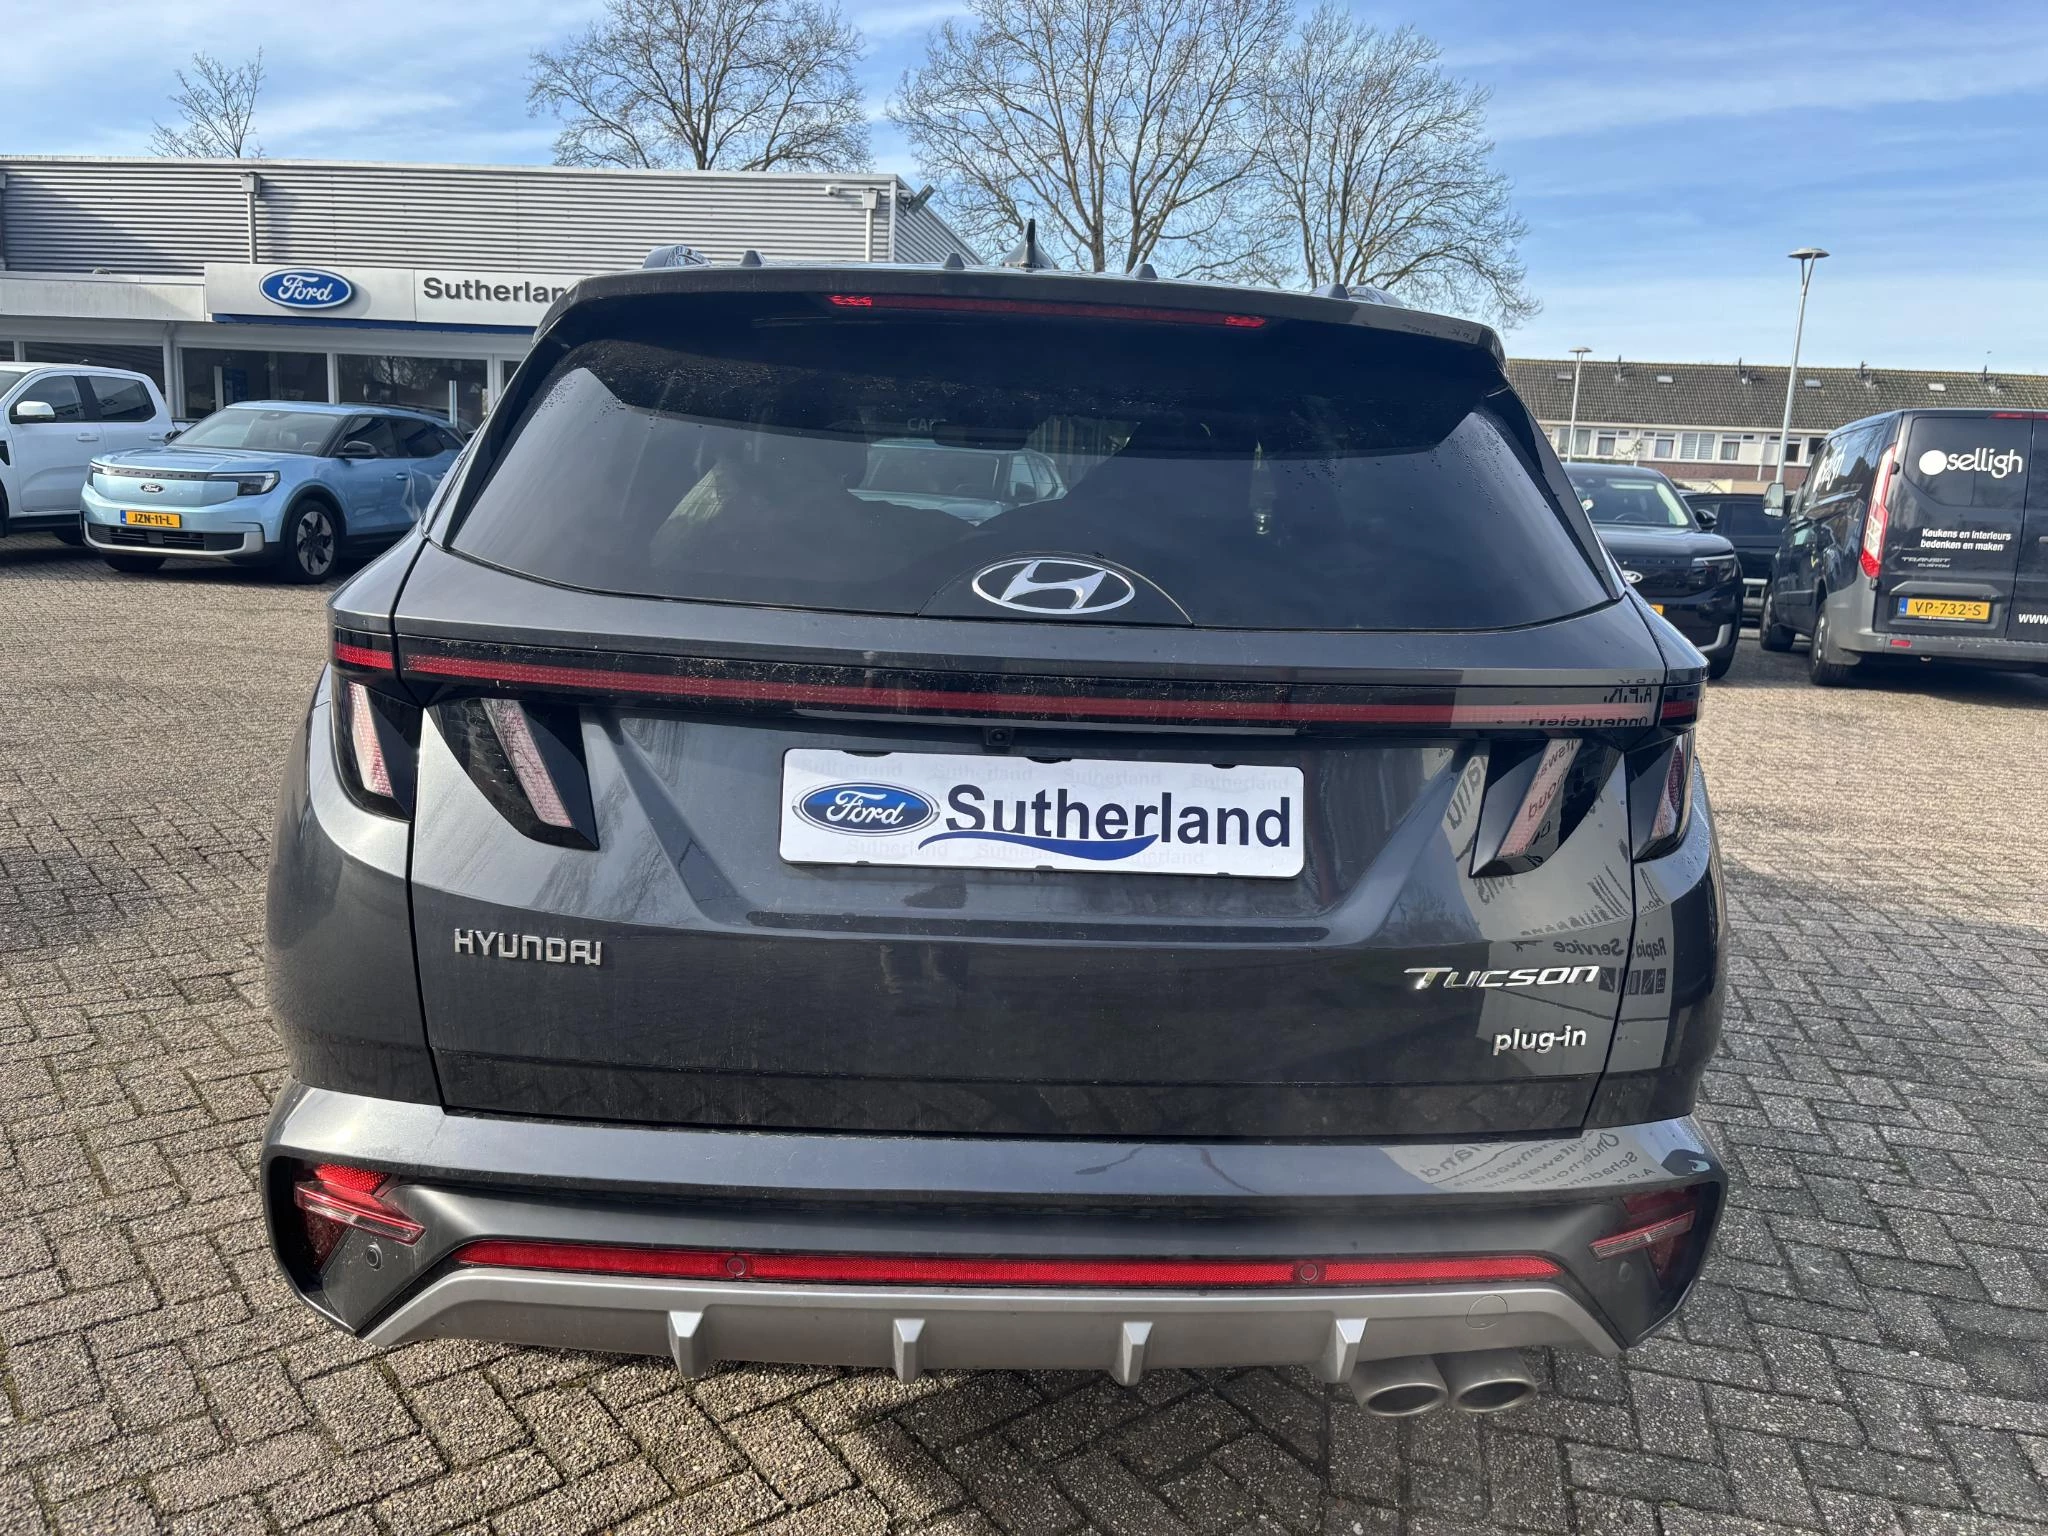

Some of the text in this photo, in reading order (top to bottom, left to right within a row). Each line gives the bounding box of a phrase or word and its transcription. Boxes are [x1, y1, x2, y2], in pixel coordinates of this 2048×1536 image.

[278, 274, 334, 303] Ford
[423, 277, 566, 303] Sutherlan
[1946, 447, 2023, 479] selligh
[132, 513, 173, 526] JZN-11-L
[1920, 539, 2004, 552] bedenken en maken
[1921, 528, 1958, 539] Keukens
[1959, 530, 1970, 539] en
[1915, 601, 1982, 616] VP-732-S
[825, 784, 1291, 848] Ford Sutherland
[454, 928, 602, 966] HYUNDAI
[1492, 1025, 1587, 1055] plug-in
